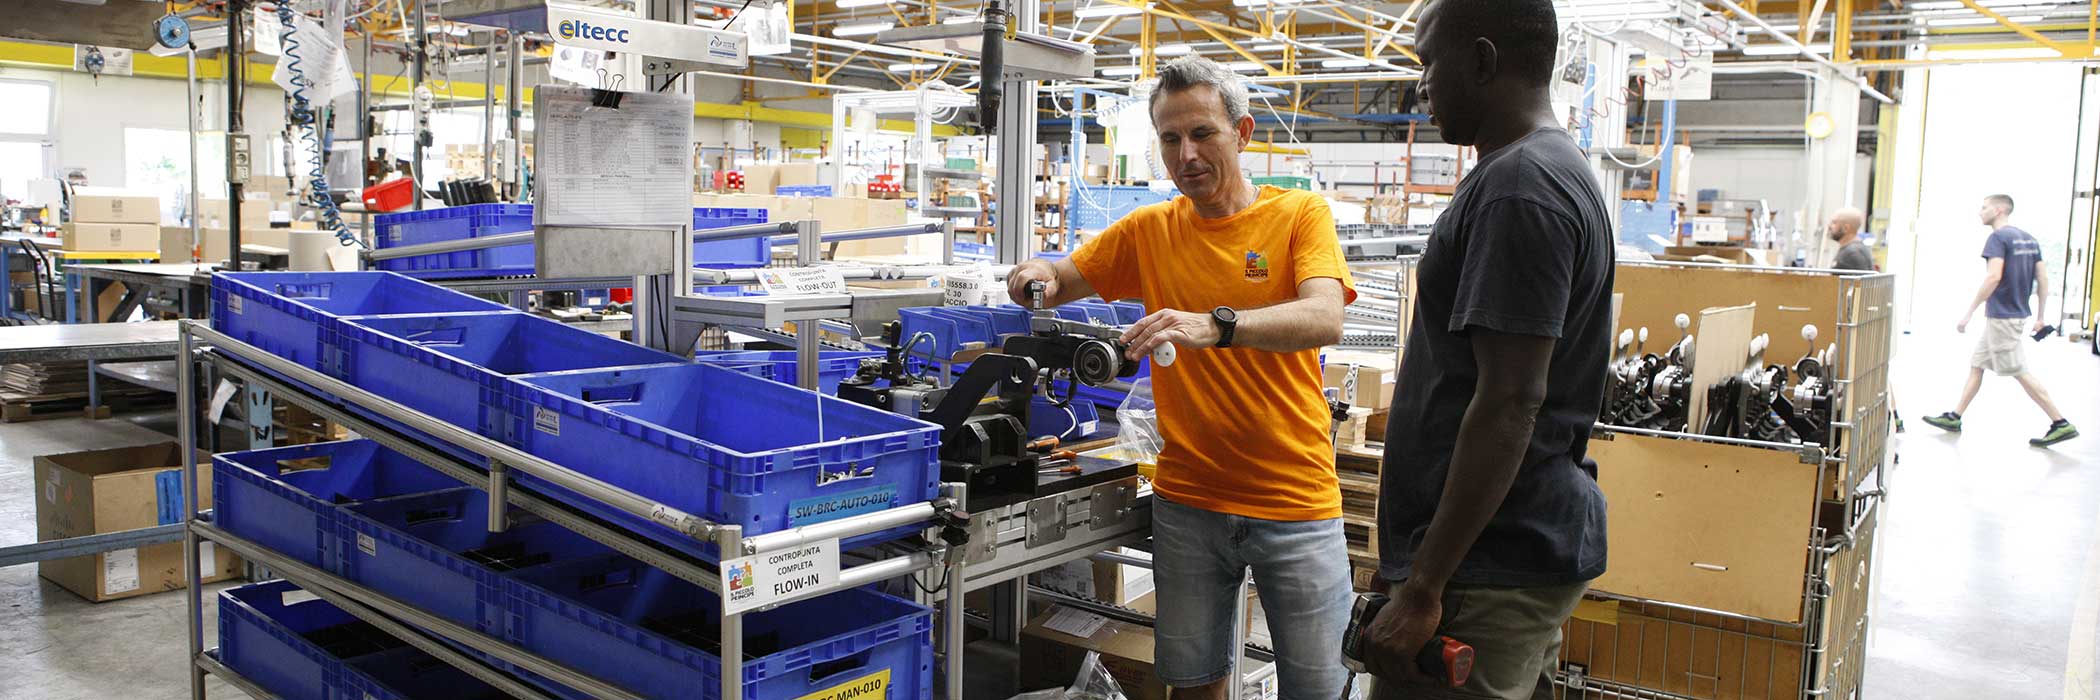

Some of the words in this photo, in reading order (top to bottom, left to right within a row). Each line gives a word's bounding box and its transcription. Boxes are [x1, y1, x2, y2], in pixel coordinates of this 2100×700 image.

[559, 20, 629, 43] eltecc
[796, 281, 837, 291] FLOW-OUT
[796, 492, 889, 518] SW-BRC-AUTO-010
[768, 546, 821, 564] CONTROPUNTA
[777, 560, 813, 575] COMPLETA
[774, 573, 819, 596] FLOW-IN
